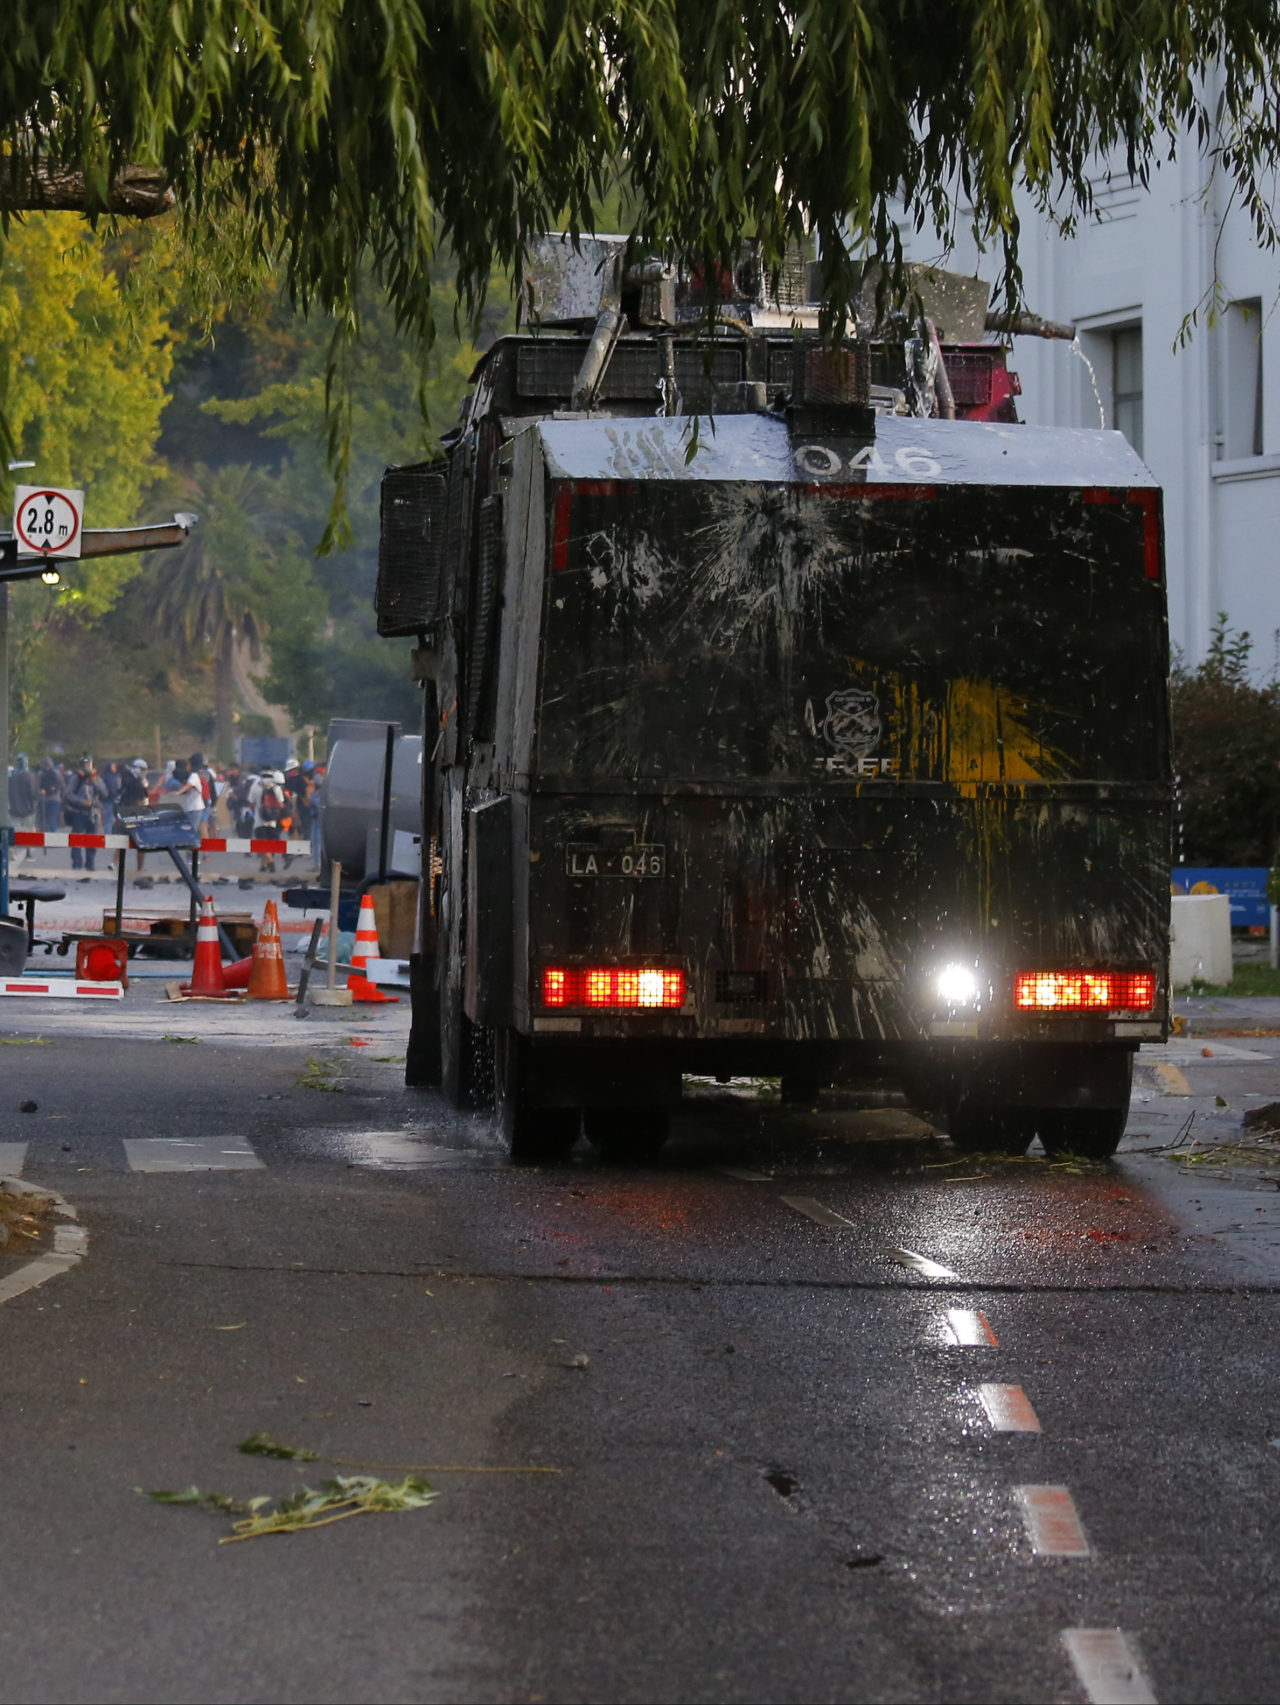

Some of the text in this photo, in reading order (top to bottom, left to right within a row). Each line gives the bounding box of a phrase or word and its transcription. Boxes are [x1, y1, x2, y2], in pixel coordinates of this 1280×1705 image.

[794, 444, 942, 477] 046
[27, 507, 68, 536] 2.8 m
[571, 852, 661, 875] LA 046
